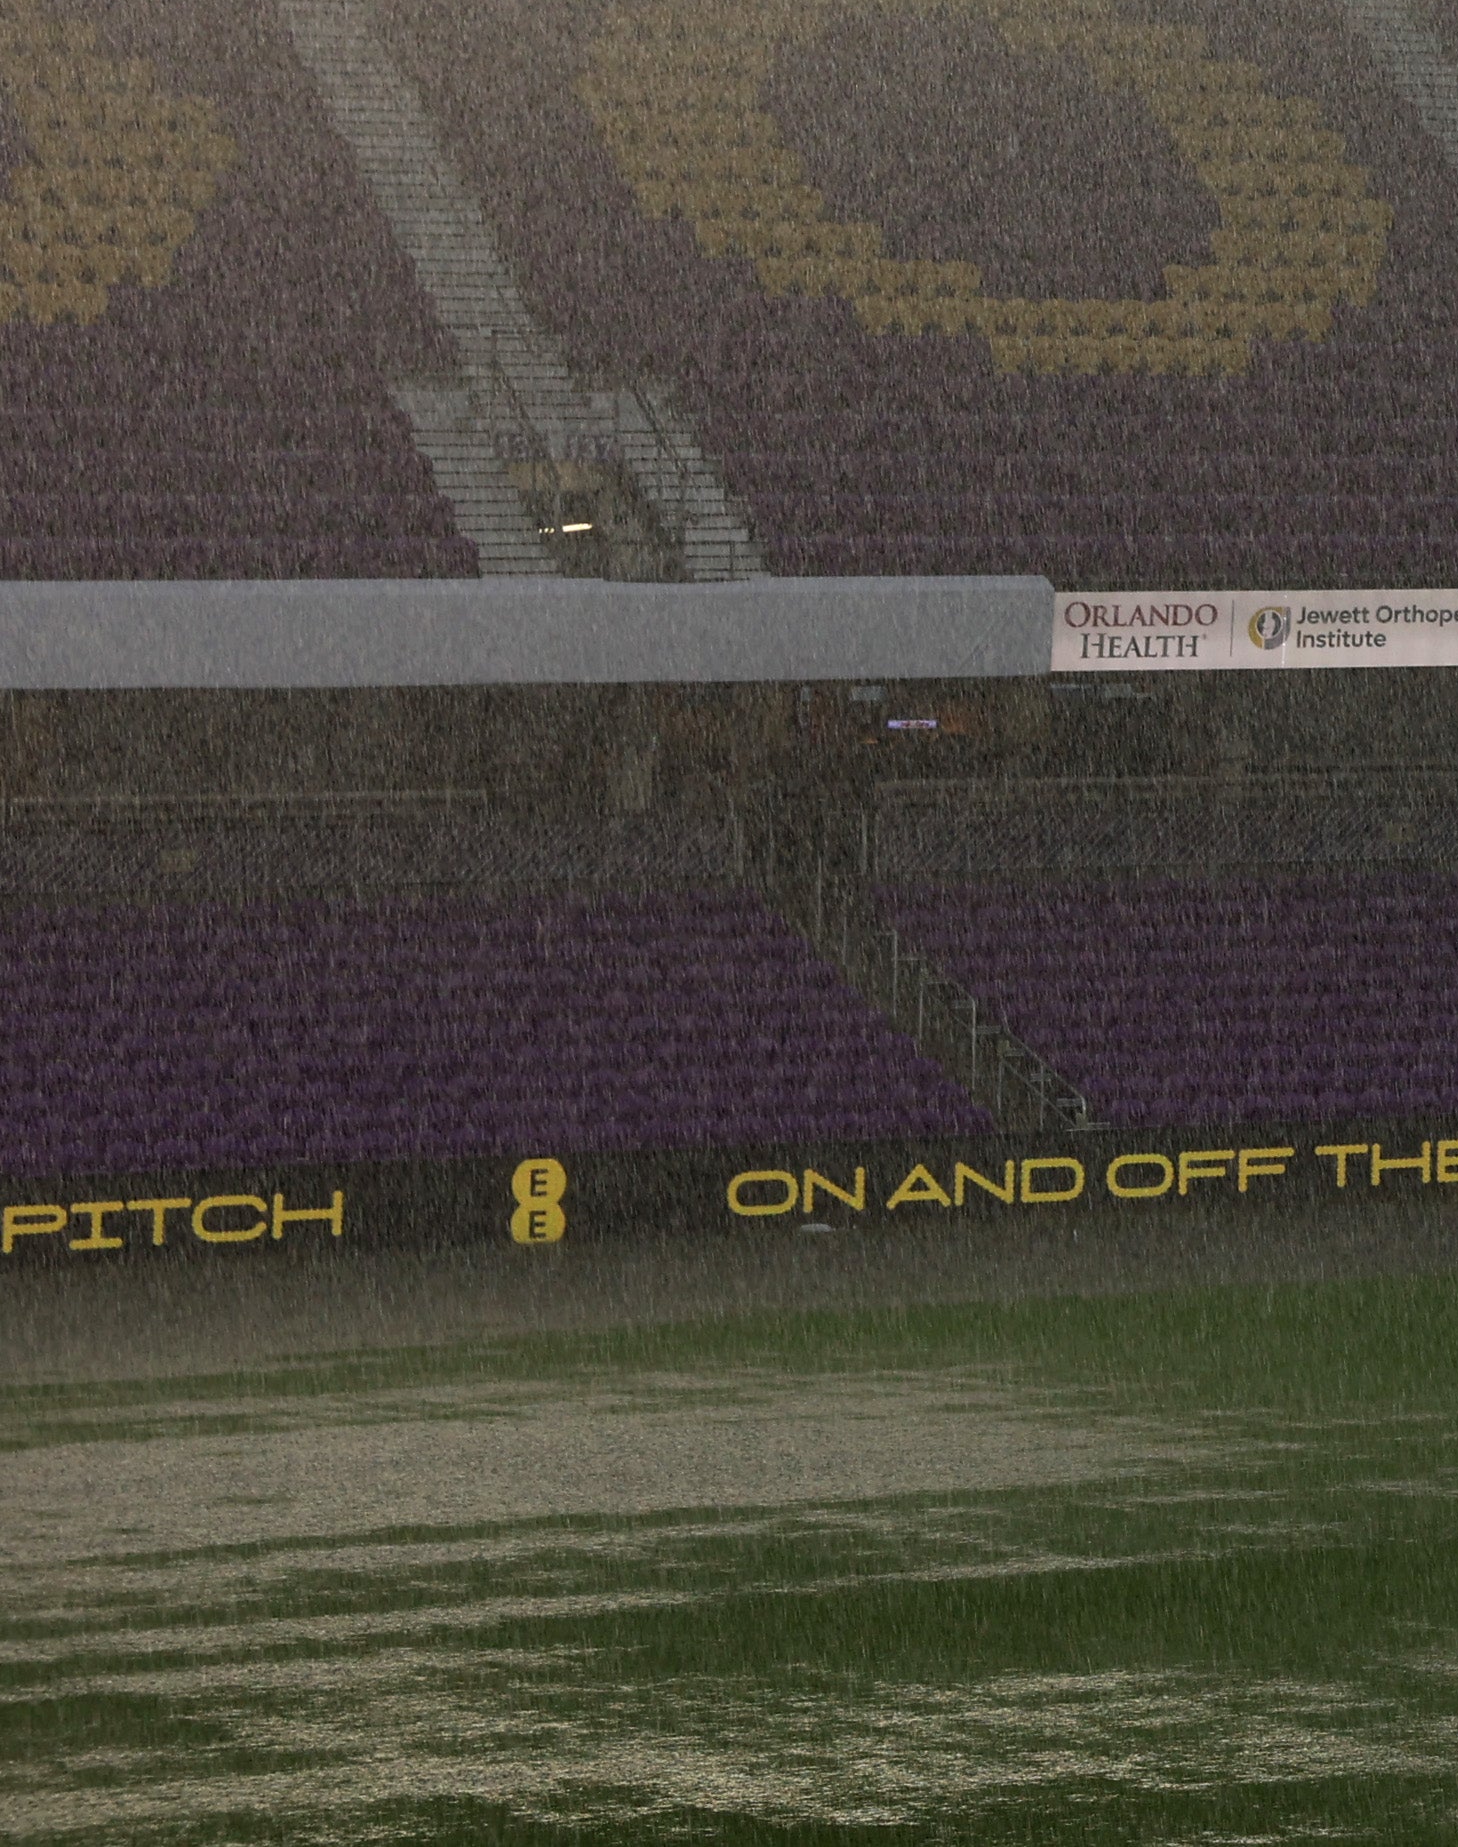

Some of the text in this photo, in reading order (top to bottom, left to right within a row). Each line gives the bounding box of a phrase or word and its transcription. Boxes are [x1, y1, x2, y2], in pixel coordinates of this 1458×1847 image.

[1064, 601, 1219, 629] ORLANDO
[1296, 605, 1371, 626] Jewett
[1296, 630, 1388, 650] Institute
[727, 1167, 866, 1217] ON
[887, 1156, 1086, 1209] AND
[1106, 1146, 1296, 1199] OFF
[1, 1190, 344, 1253] PITCH
